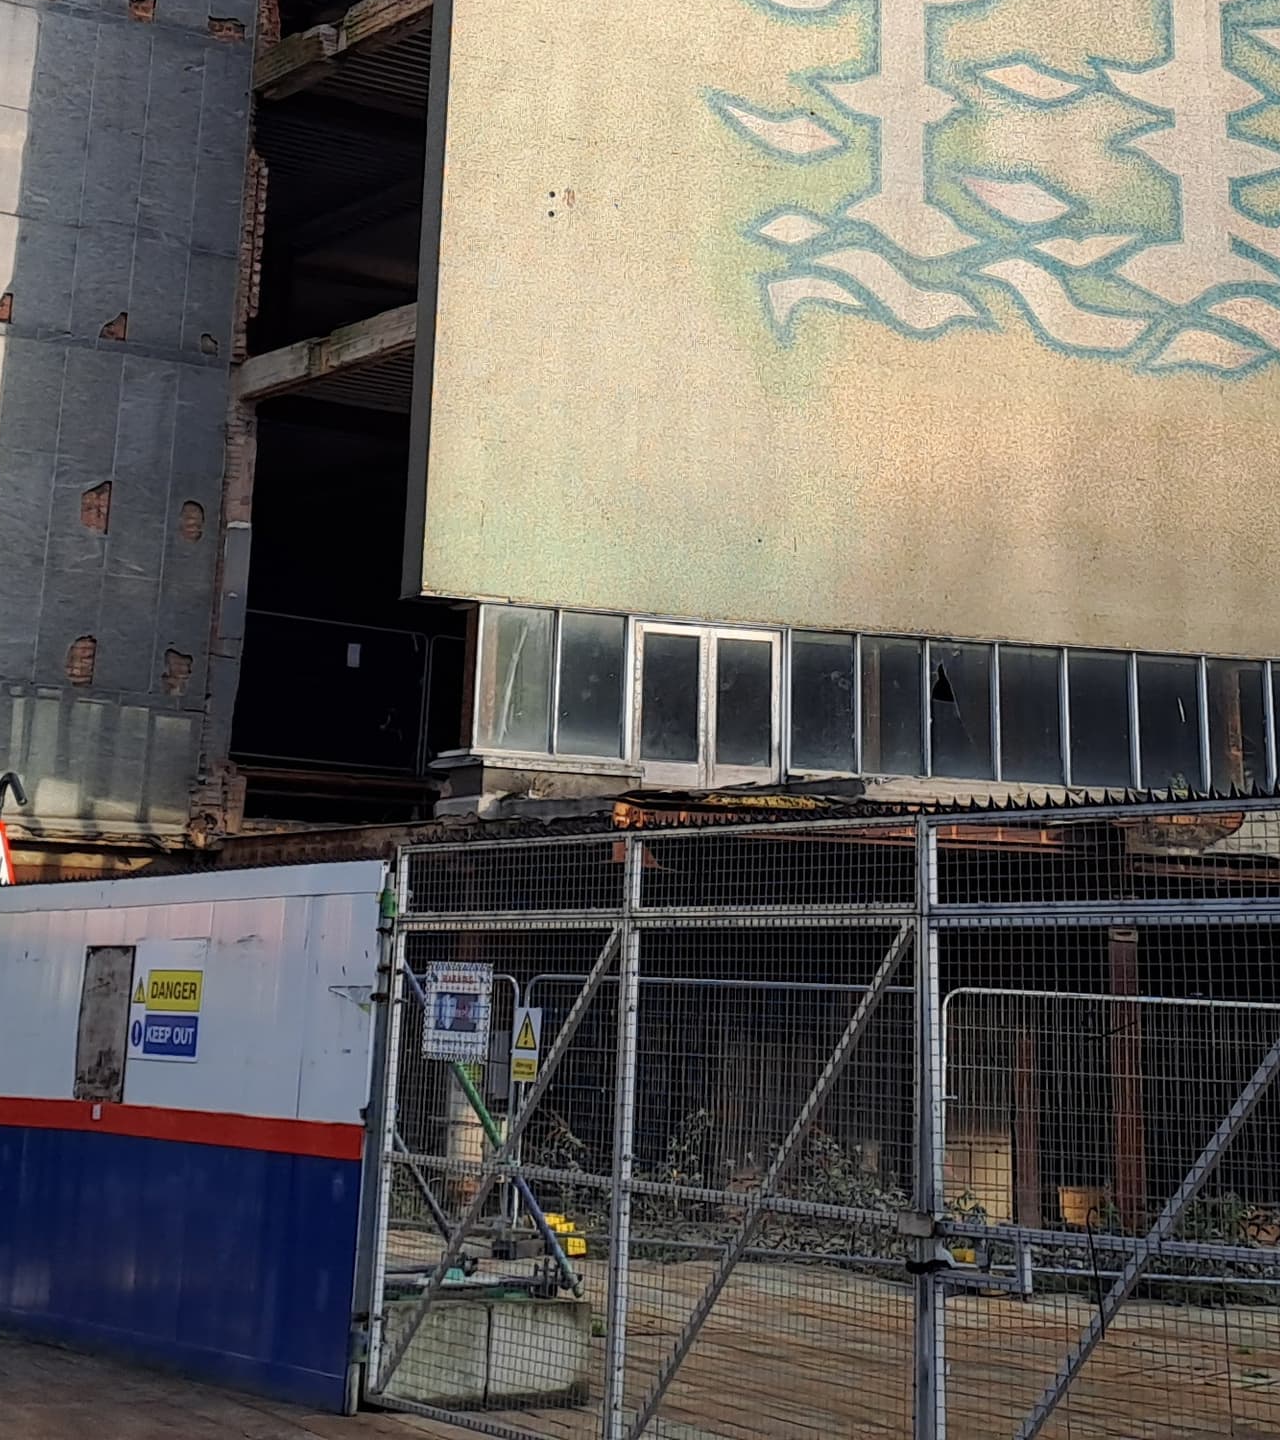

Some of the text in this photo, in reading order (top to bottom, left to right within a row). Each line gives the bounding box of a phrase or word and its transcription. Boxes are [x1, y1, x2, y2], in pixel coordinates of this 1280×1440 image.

[150, 981, 198, 1000] DANGER
[145, 1025, 196, 1045] KEEP OUT
